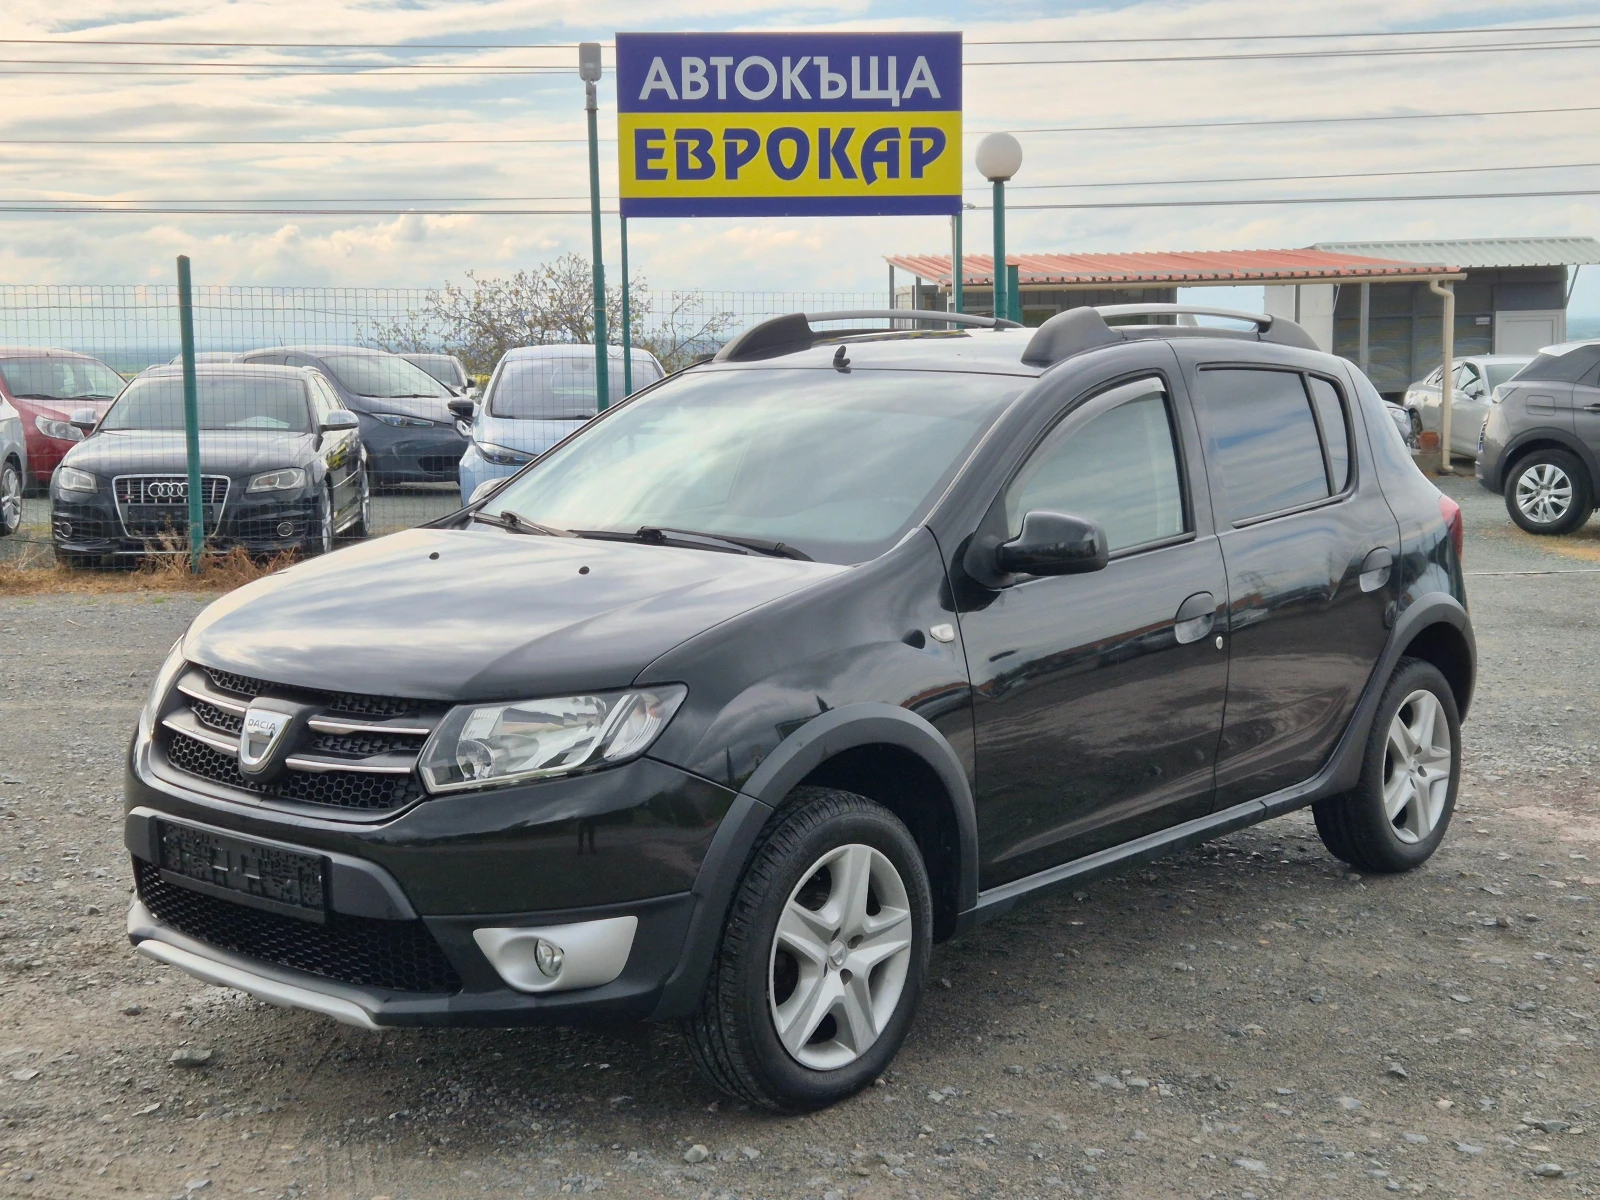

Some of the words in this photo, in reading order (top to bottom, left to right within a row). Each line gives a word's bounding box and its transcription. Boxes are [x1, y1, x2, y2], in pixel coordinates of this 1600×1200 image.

[638, 55, 941, 107] АВТОКЪЩА
[634, 126, 947, 186] ЕВРОКАР
[247, 718, 276, 731] DACIA
